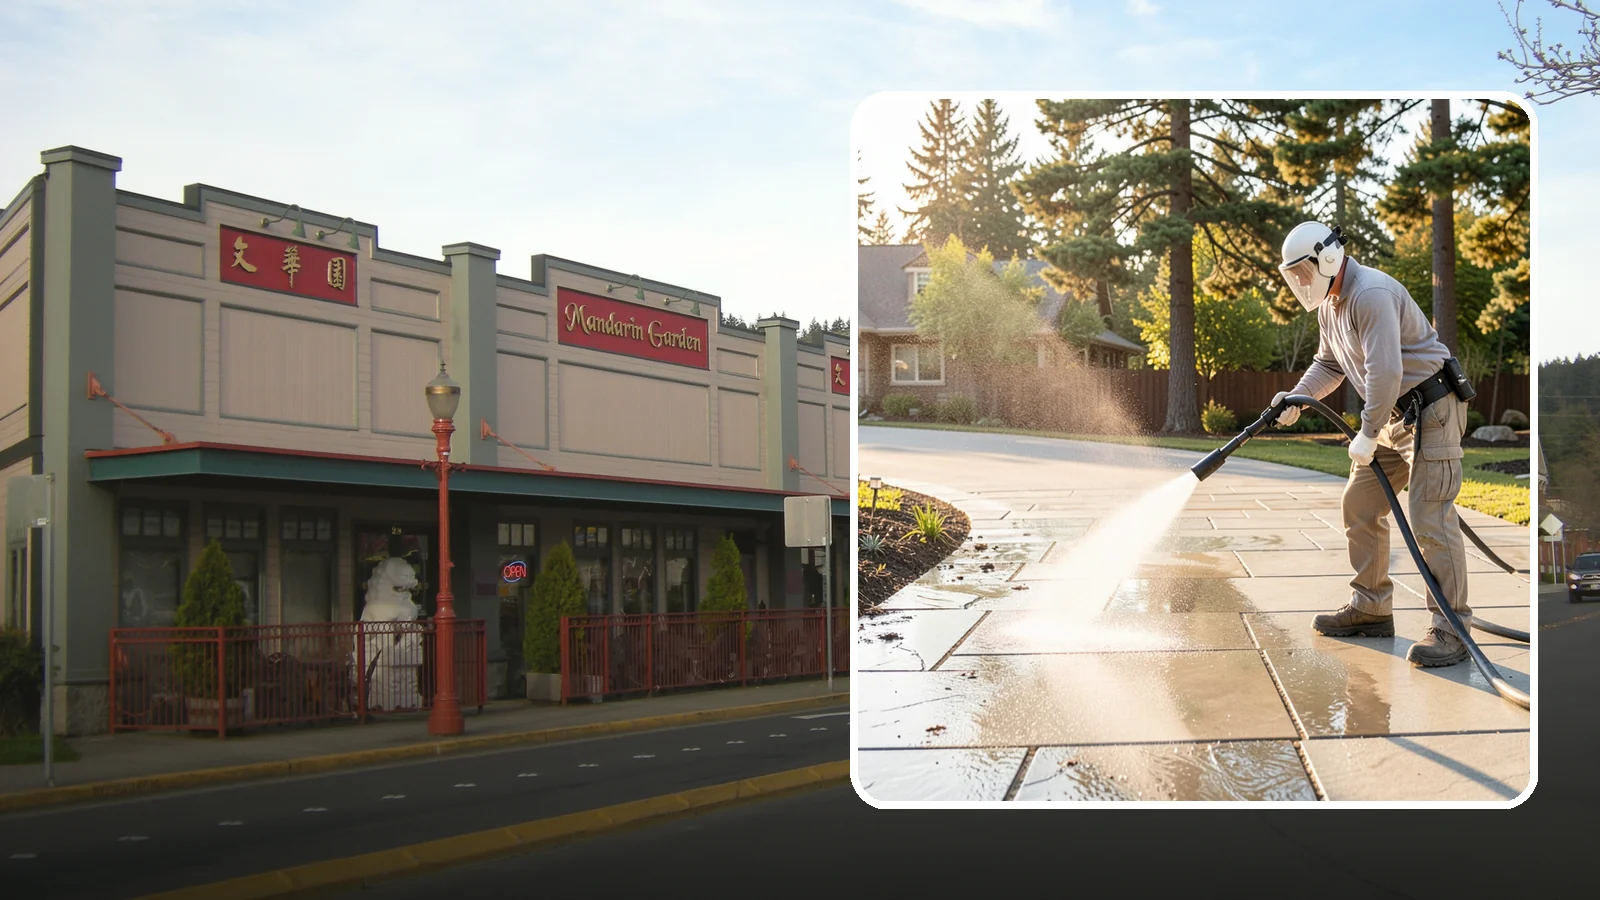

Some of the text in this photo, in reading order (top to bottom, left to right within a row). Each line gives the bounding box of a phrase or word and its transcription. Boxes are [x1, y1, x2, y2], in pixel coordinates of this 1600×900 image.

[564, 302, 701, 352] Mandarin Garden
[503, 565, 527, 578] OPEN
